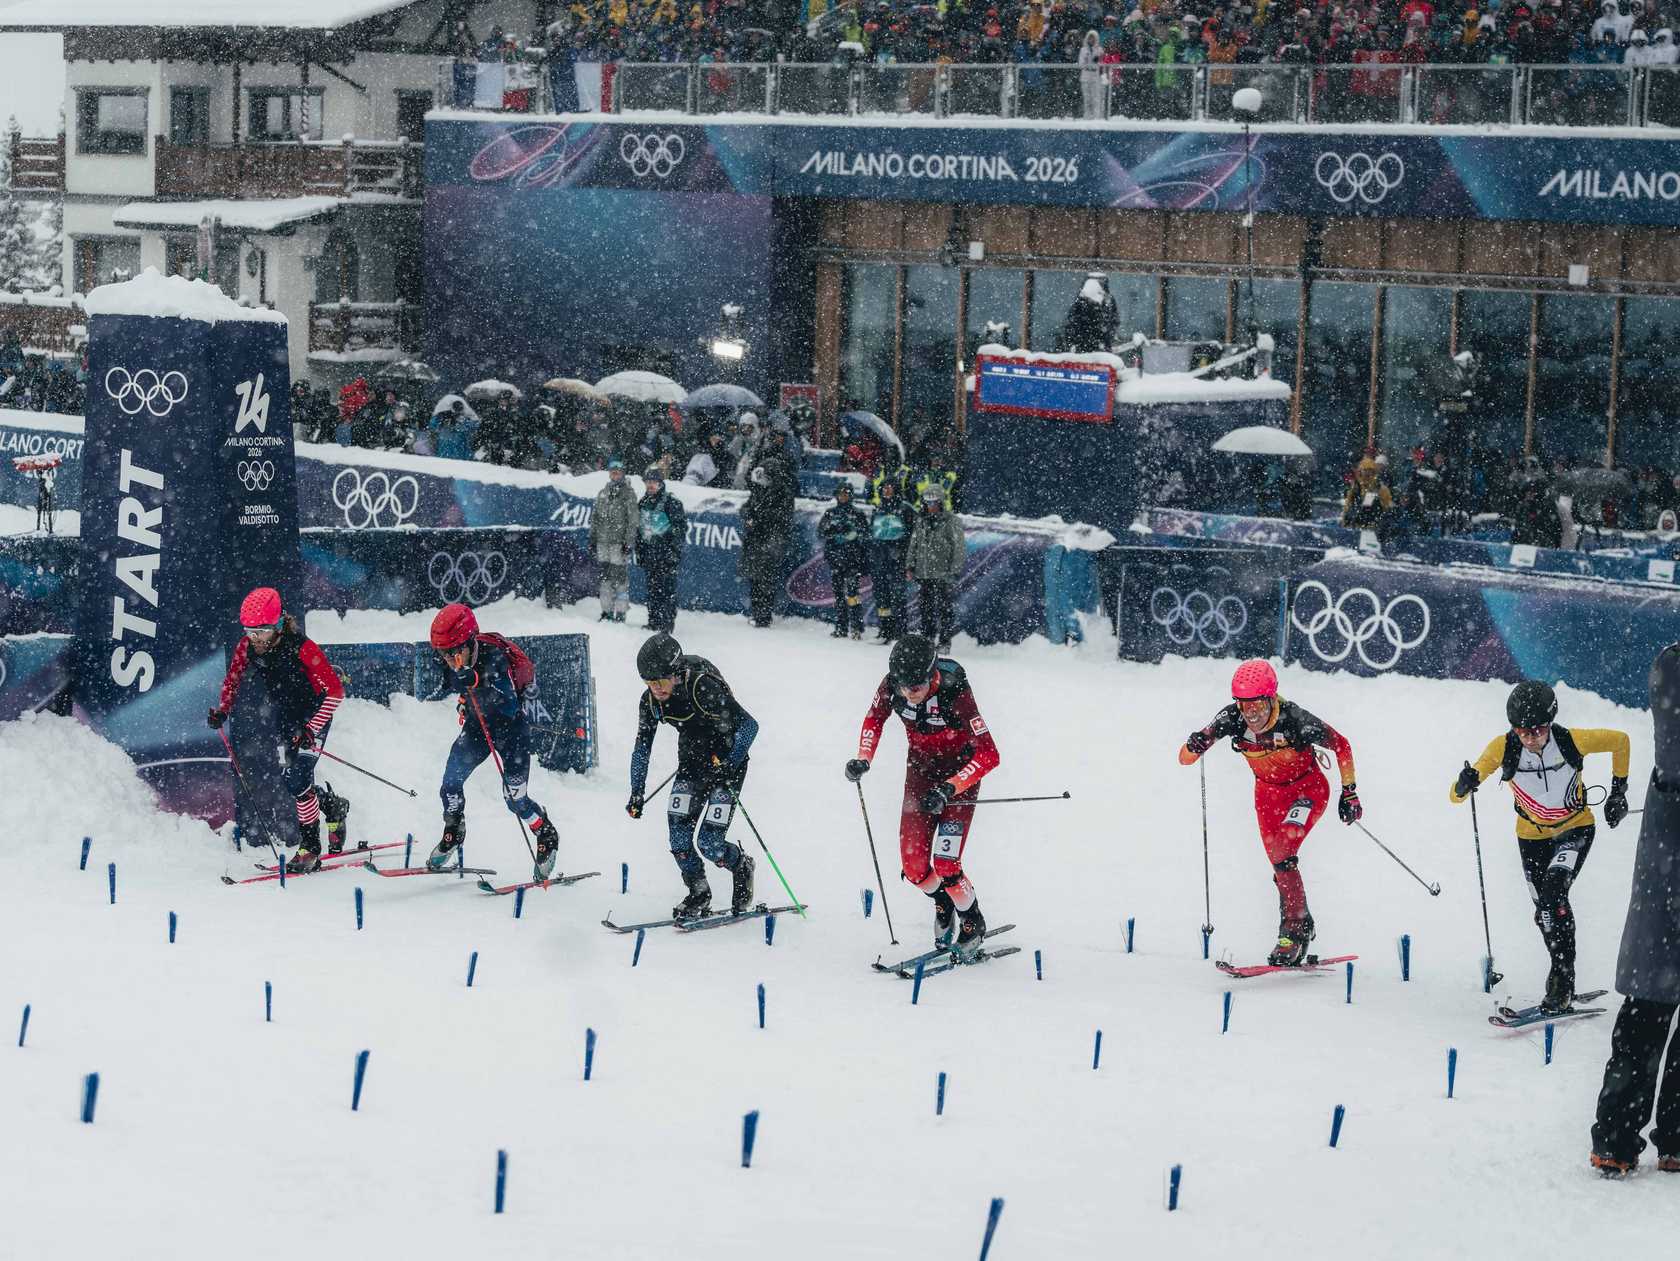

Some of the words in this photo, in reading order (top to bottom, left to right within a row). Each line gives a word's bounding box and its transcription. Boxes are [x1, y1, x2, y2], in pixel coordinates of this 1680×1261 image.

[800, 151, 903, 178] MILANO
[908, 154, 1018, 181] CORTINA
[1024, 156, 1079, 182] 2026
[1538, 169, 1680, 200] MILANO
[0, 432, 42, 454] LANO
[44, 437, 84, 459] CORT
[224, 437, 253, 447] MILANO
[254, 436, 285, 446] CORTINA
[248, 447, 262, 457] 2026
[244, 505, 271, 515] BORMIO
[239, 514, 279, 525] VALDISOTTO
[686, 522, 743, 549] TINA
[111, 448, 164, 692] START
[957, 760, 982, 781] SUI
[672, 797, 681, 809] 8
[713, 807, 722, 819] 8
[942, 838, 951, 852] 3
[1557, 853, 1567, 863] 5
